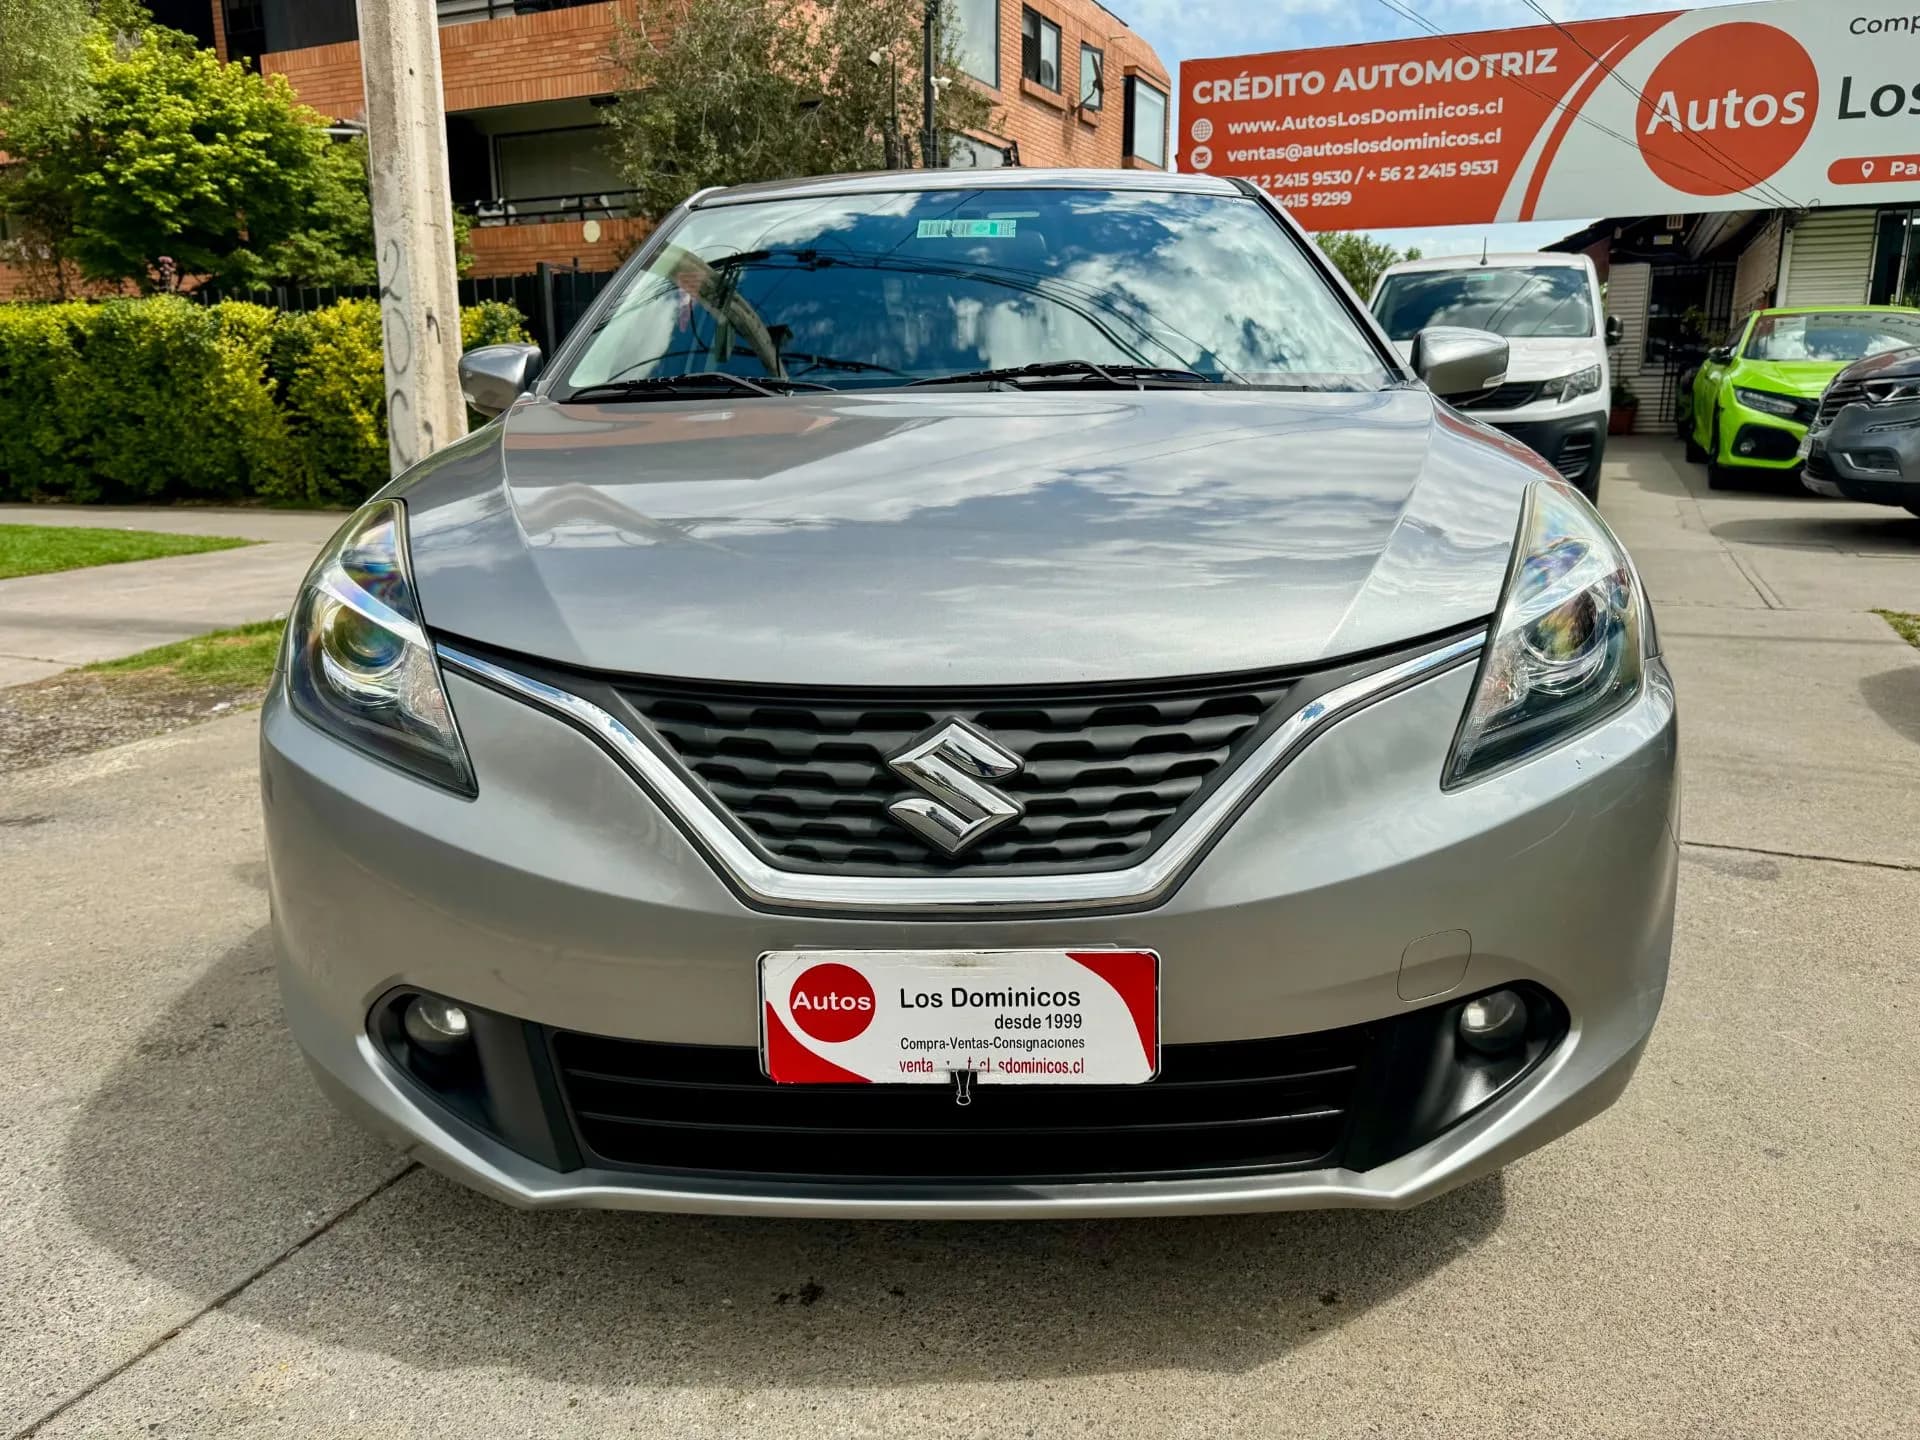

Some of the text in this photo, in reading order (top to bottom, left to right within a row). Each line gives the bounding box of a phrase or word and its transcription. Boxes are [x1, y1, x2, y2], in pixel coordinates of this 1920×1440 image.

[1192, 48, 1558, 104] CRÉDITO AUTOMOTRIZ
[1228, 98, 1503, 135] www.AutosLosDominicos.cl
[1645, 89, 1806, 136] Autos
[1227, 128, 1501, 162] ventas@autoslosdominicos.cl
[1274, 172, 1309, 187] 2415
[1312, 169, 1352, 186] 9530
[1380, 166, 1401, 182] 56
[1404, 165, 1415, 180] 2
[1418, 162, 1456, 179] 2415
[1460, 159, 1498, 176] 9531
[1890, 161, 1920, 176] Pa
[1311, 191, 1352, 206] 9299
[791, 991, 872, 1011] Autos
[900, 987, 1081, 1009] Los Dominicos
[994, 1014, 1082, 1029] desde 1999
